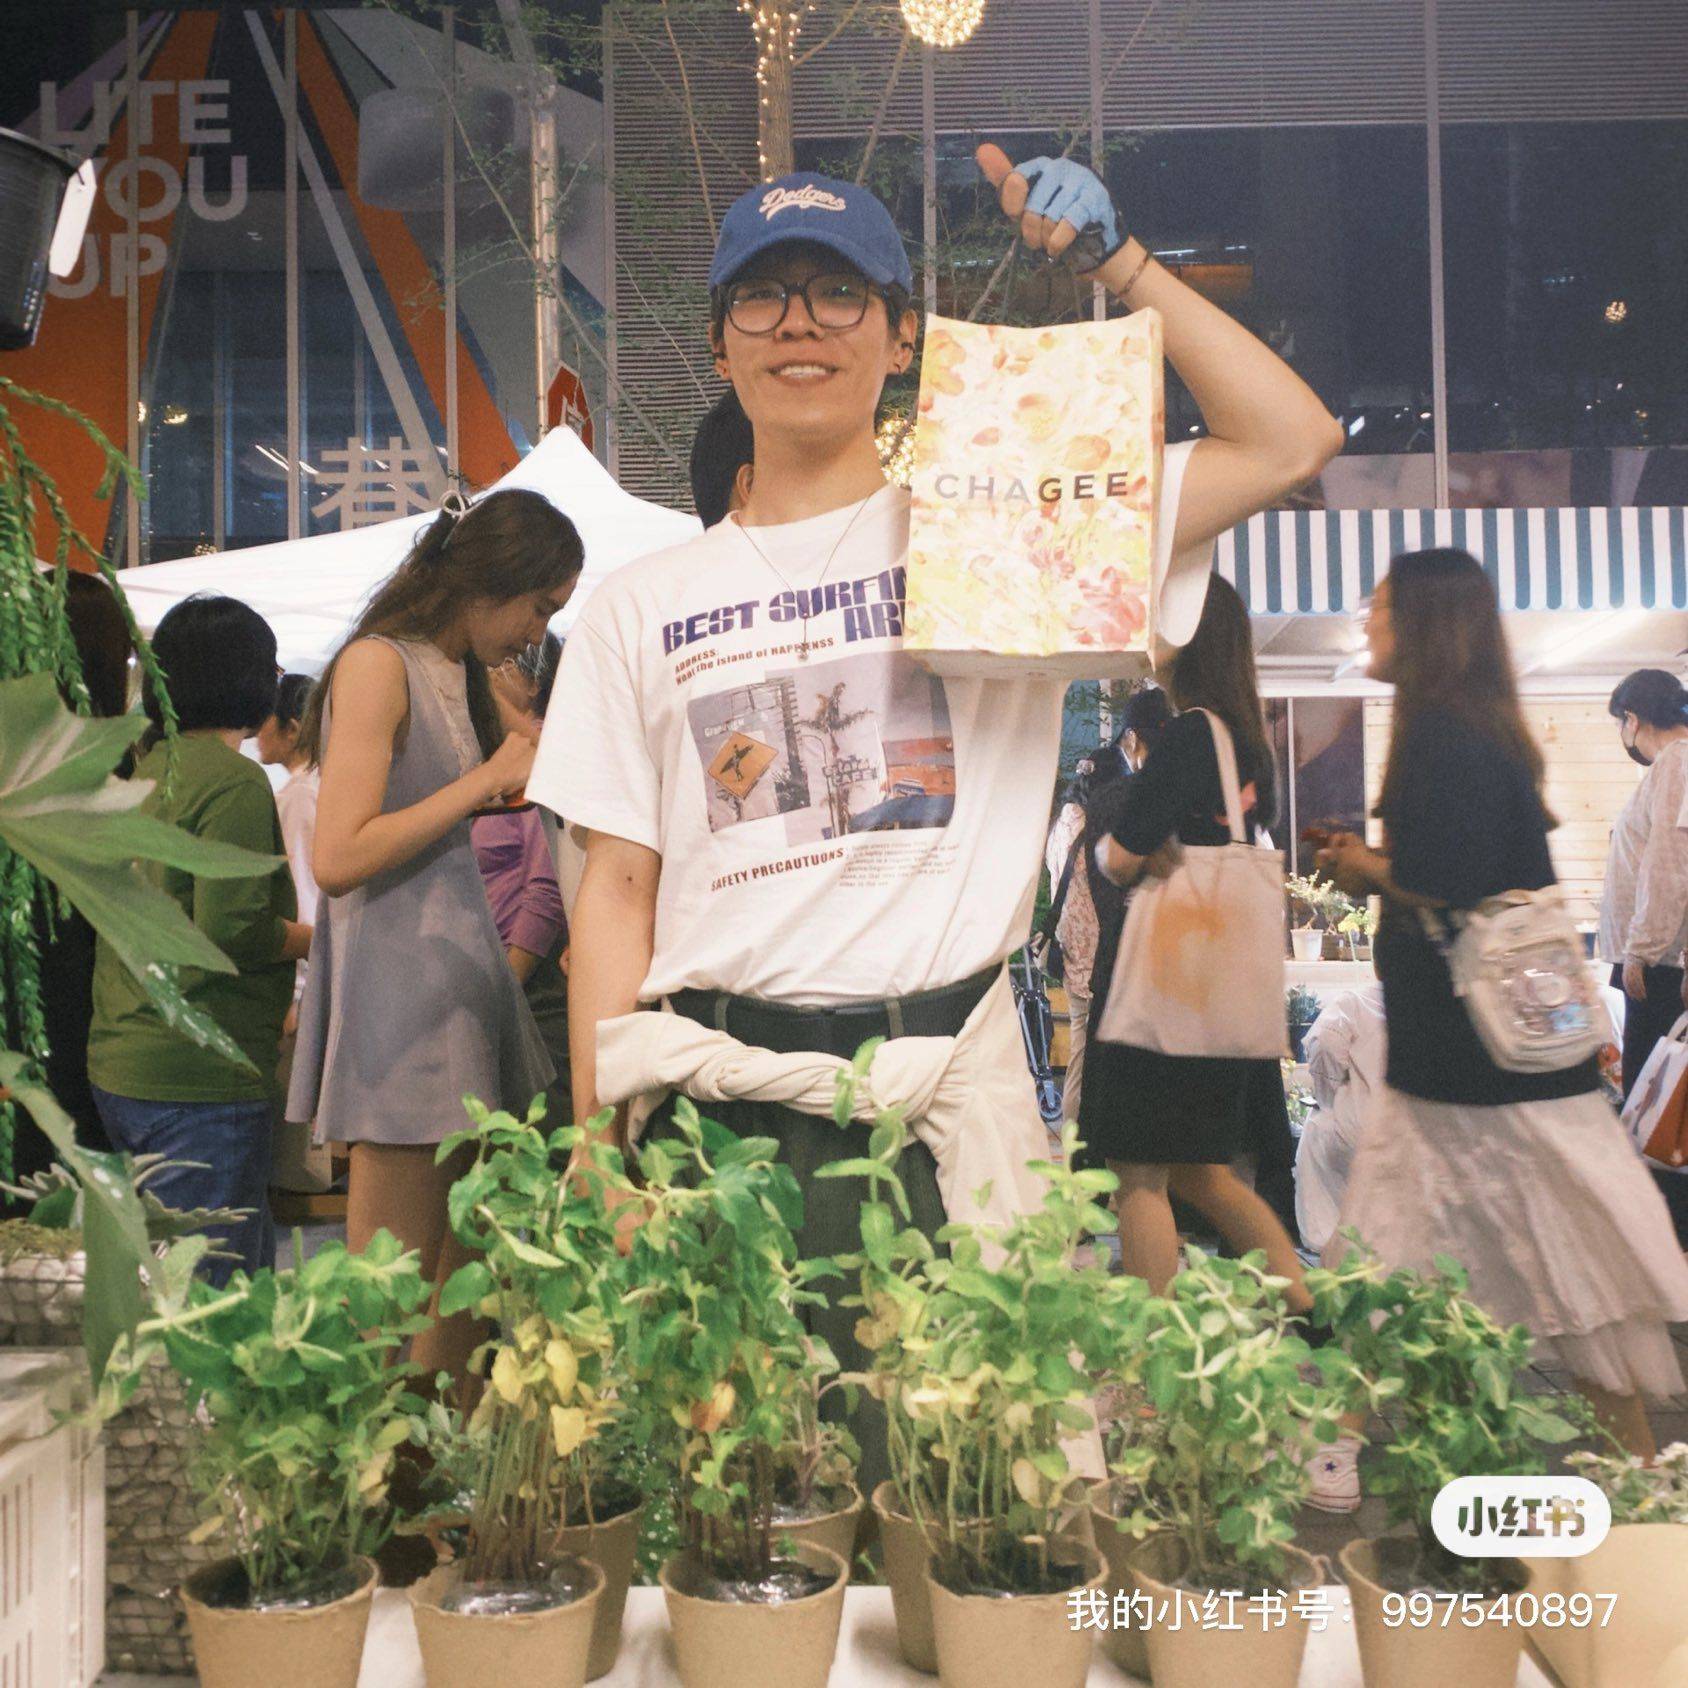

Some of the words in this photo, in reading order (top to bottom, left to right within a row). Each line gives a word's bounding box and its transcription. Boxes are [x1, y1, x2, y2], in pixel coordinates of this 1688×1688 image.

[40, 80, 231, 144] LITE
[85, 155, 248, 222] OU
[934, 471, 1129, 504] CHAGEE
[662, 600, 760, 657] BEST
[843, 600, 906, 643] AR
[711, 869, 748, 891] SAFETY
